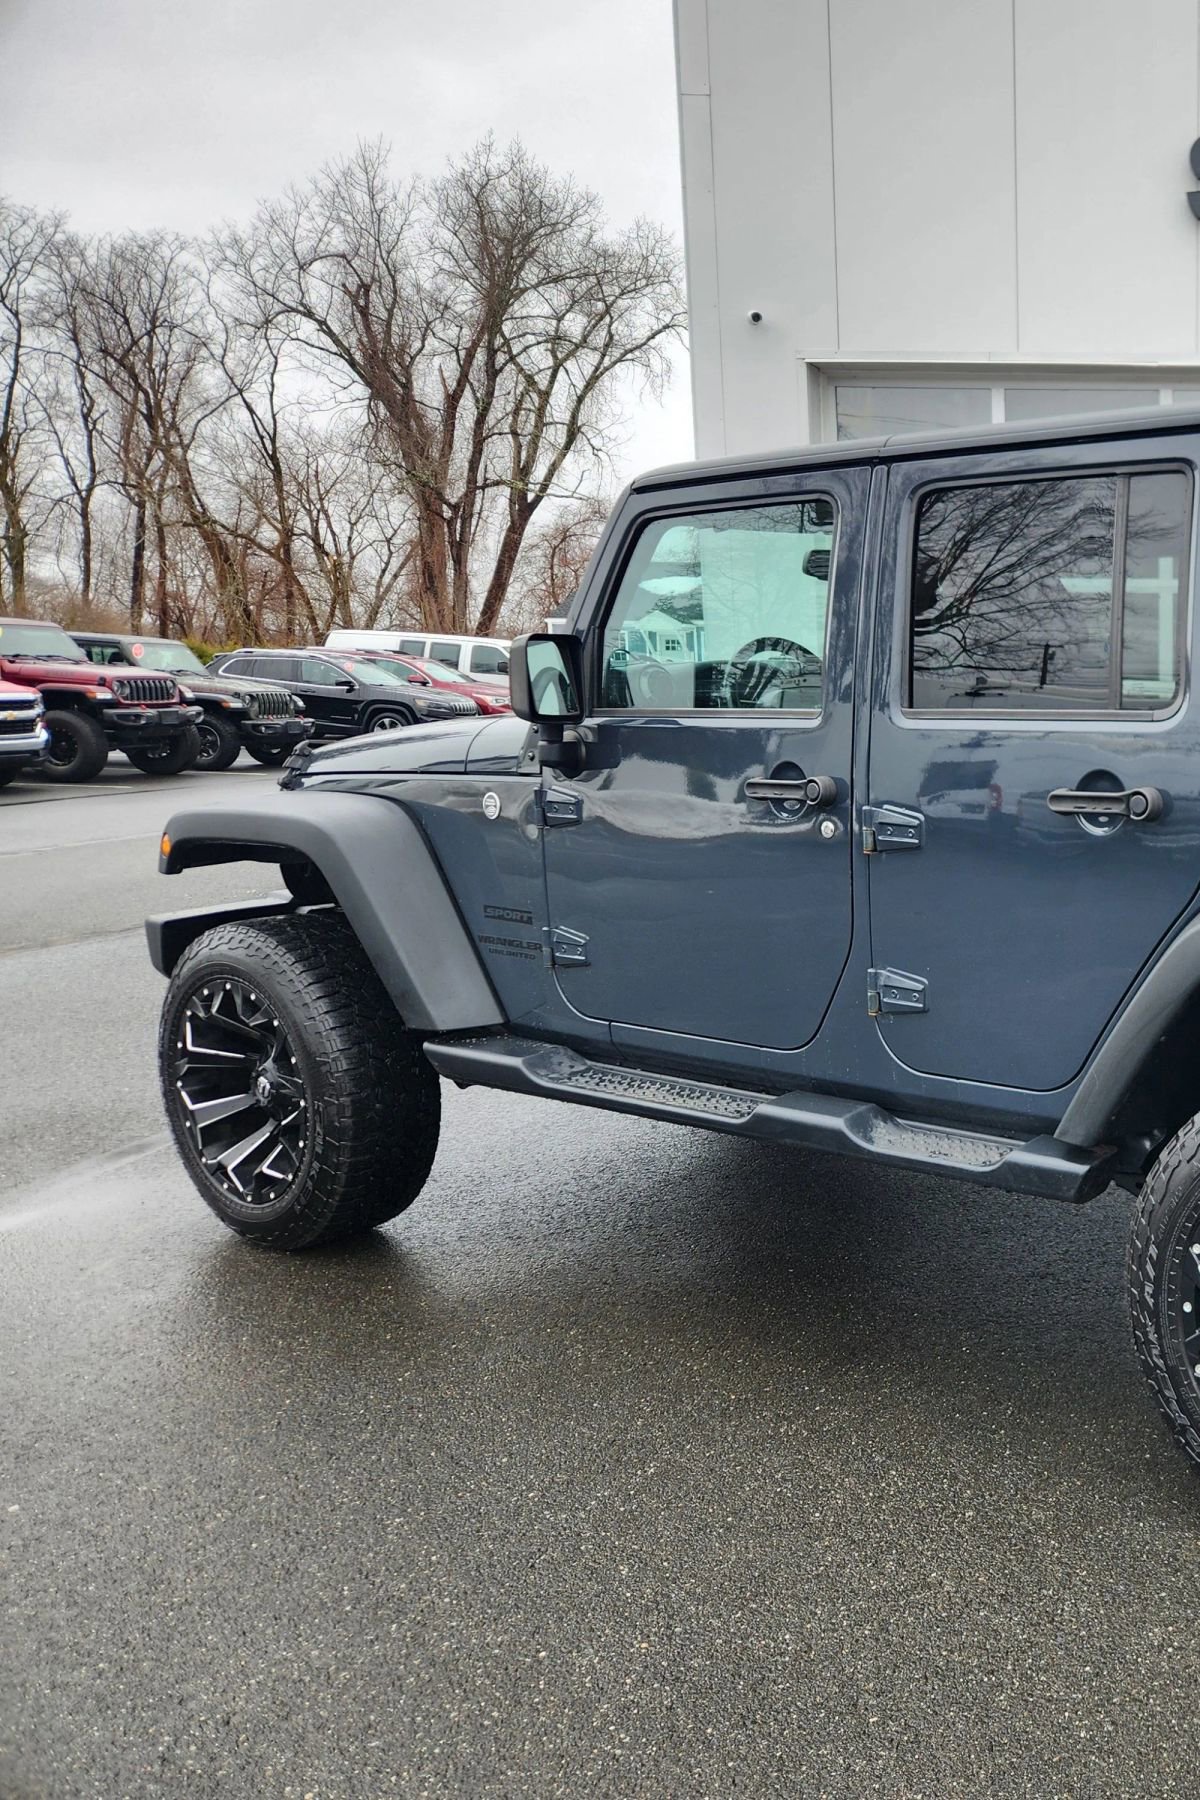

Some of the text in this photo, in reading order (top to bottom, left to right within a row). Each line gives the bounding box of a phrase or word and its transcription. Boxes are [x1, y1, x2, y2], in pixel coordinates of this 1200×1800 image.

[486, 908, 532, 921] SPORT
[479, 935, 543, 952] WRANGLER
[489, 947, 536, 960] UNLIMITED
